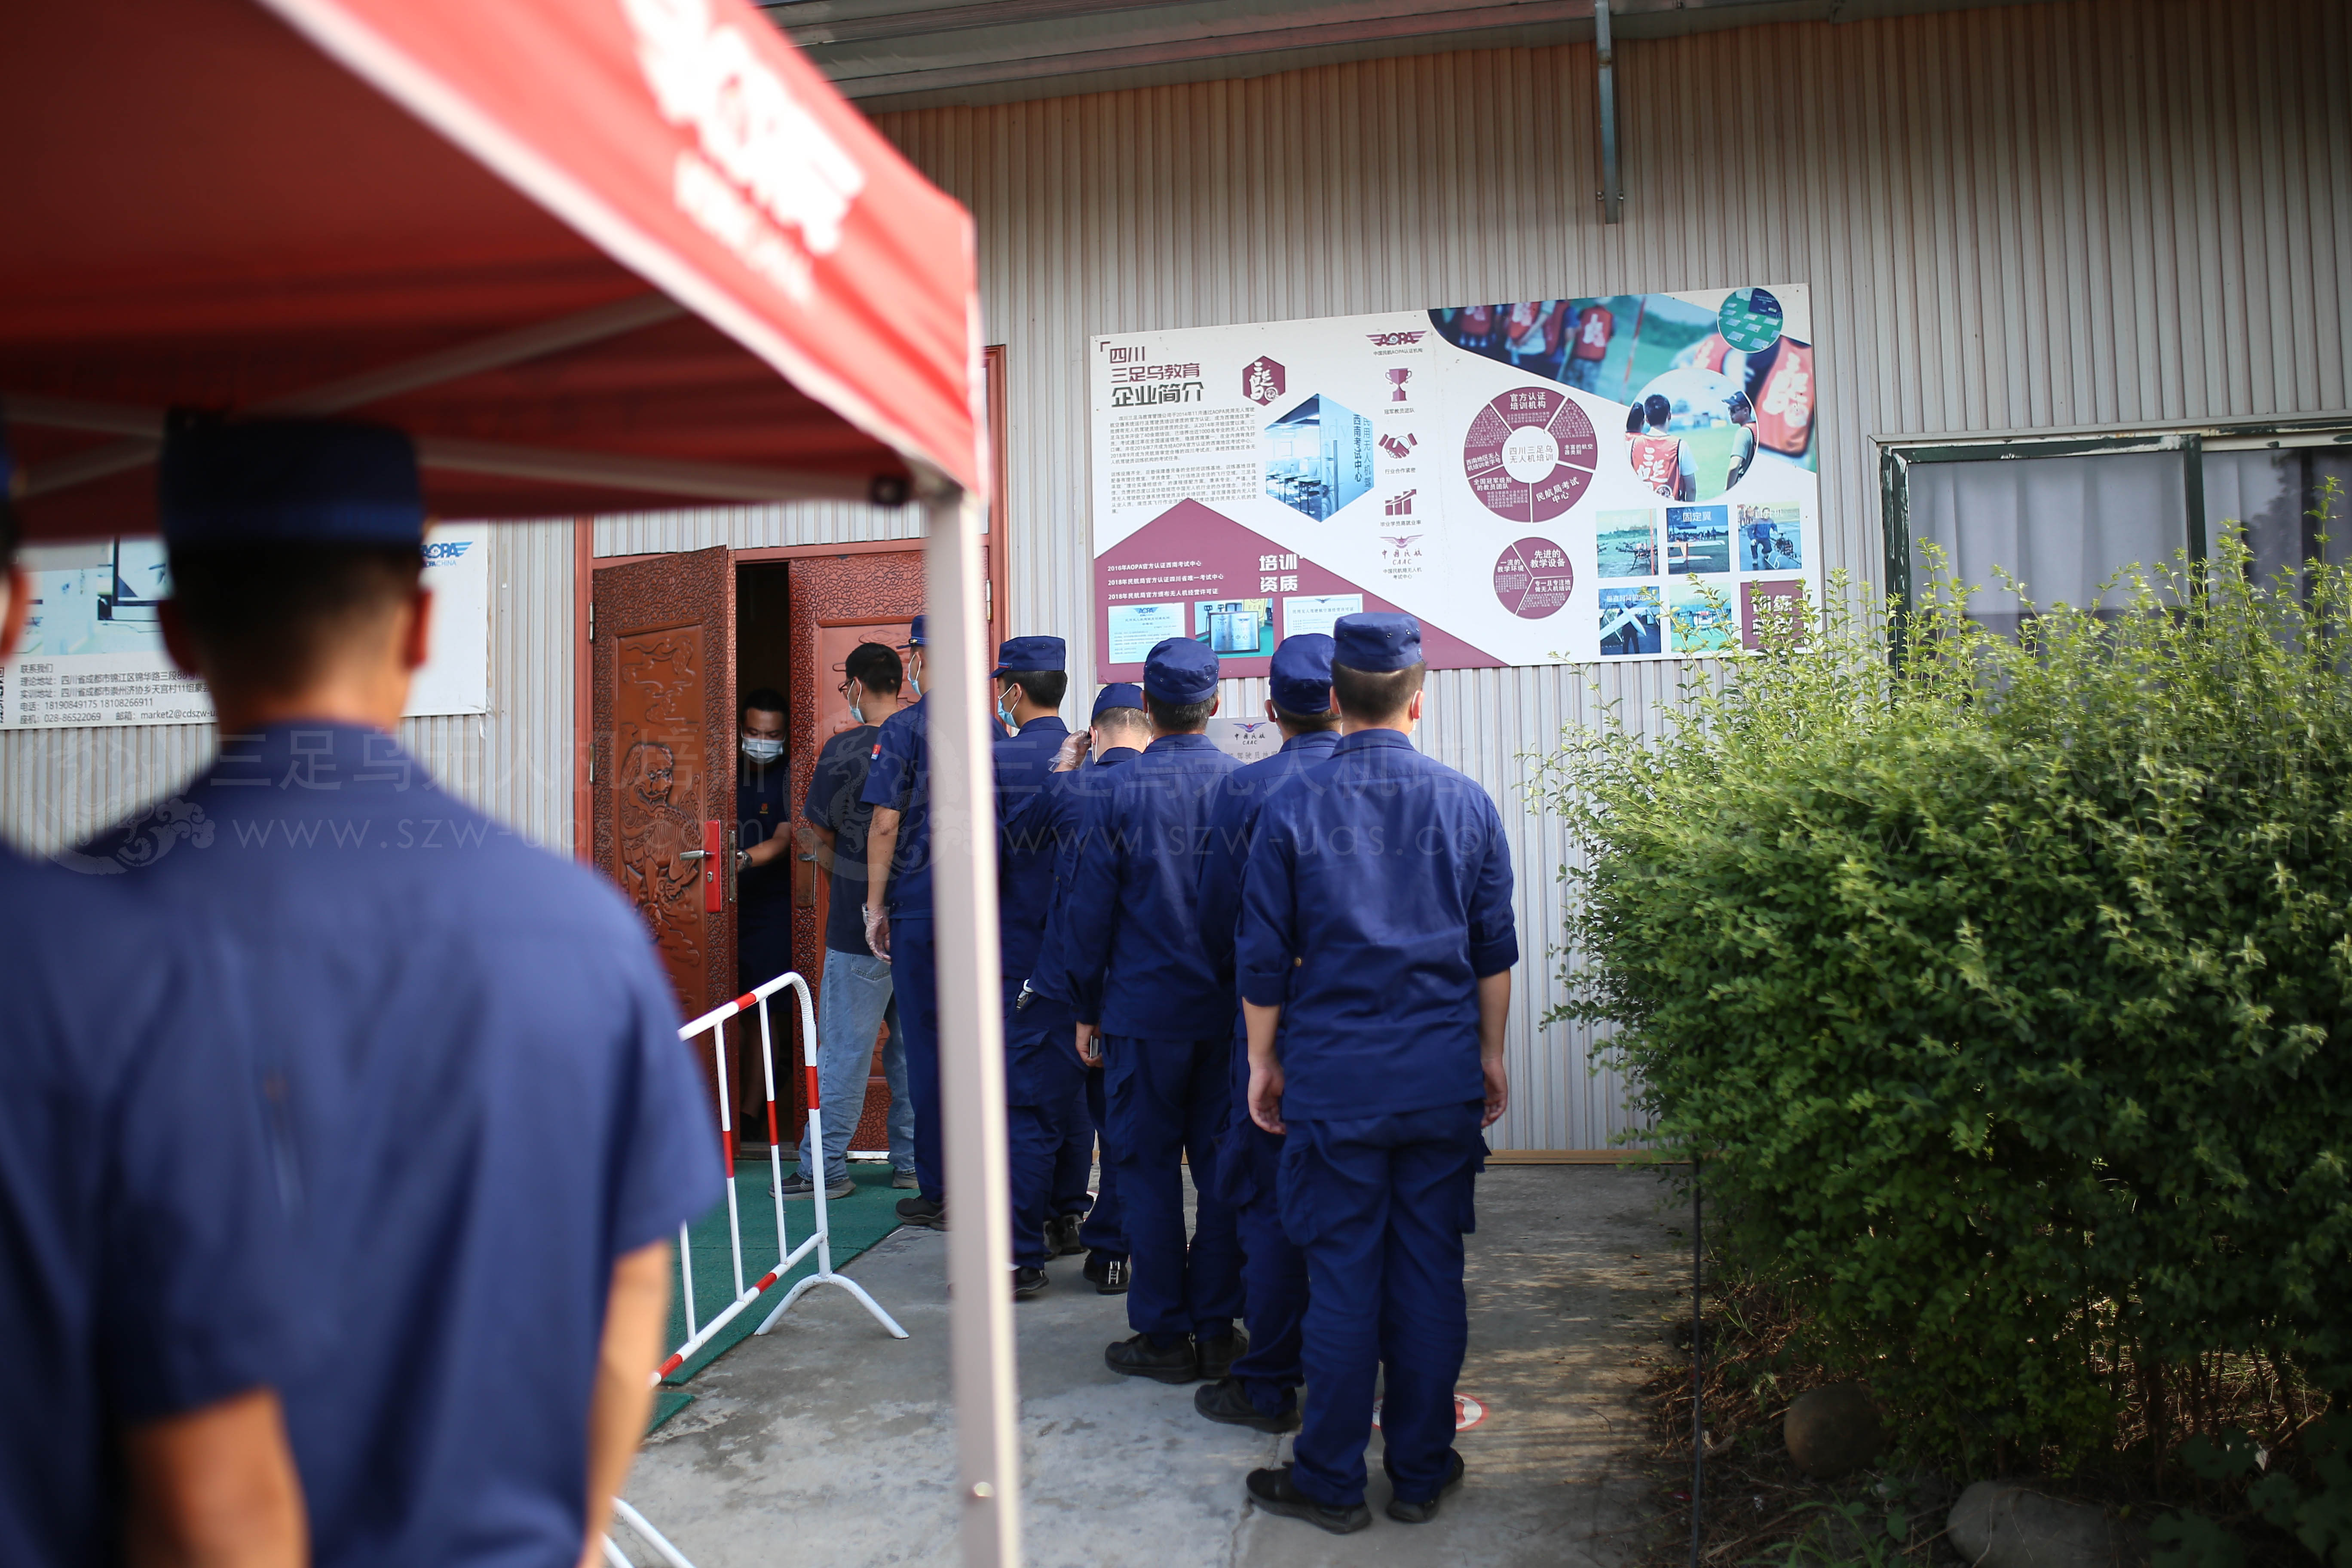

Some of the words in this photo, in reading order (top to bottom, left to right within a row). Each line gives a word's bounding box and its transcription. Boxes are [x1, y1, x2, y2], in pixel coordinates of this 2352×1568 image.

[1109, 346, 1145, 364] 四川
[1111, 363, 1200, 383] 三足乌教育
[1112, 382, 1204, 407] 企业简介
[1510, 392, 1546, 402] 官方认证
[1510, 401, 1546, 410] 培训机构
[1354, 414, 1362, 482] 西南考试中心
[1509, 445, 1553, 455] 四川三足乌
[1363, 418, 1371, 492] 民用无人机驾
[1466, 452, 1500, 467] 西南地区无人
[1510, 454, 1553, 464] 无人机培训
[1467, 457, 1501, 471] 机培训老字号
[1473, 477, 1512, 486] 全国冠军级别
[1536, 477, 1579, 502] 民航局考试
[1552, 491, 1569, 503] 中心
[1682, 511, 1712, 523] 固定翼
[1534, 549, 1561, 559] 先进的
[1107, 560, 1202, 572] 2016年AOPA官方认证西南考试中心
[1259, 554, 1298, 572] 培训
[1530, 558, 1565, 568] 教学设备
[1108, 574, 1224, 586] 2018年民航局官方认证四川省唯一考试中心
[1259, 575, 1298, 593] 资质
[1108, 588, 1219, 600] 2018年民航局官方颁布无人机经营许可证
[1606, 594, 1649, 602] 垂直起降固定
[20, 664, 53, 673] 联系我们
[101, 698, 153, 707] 18108266911
